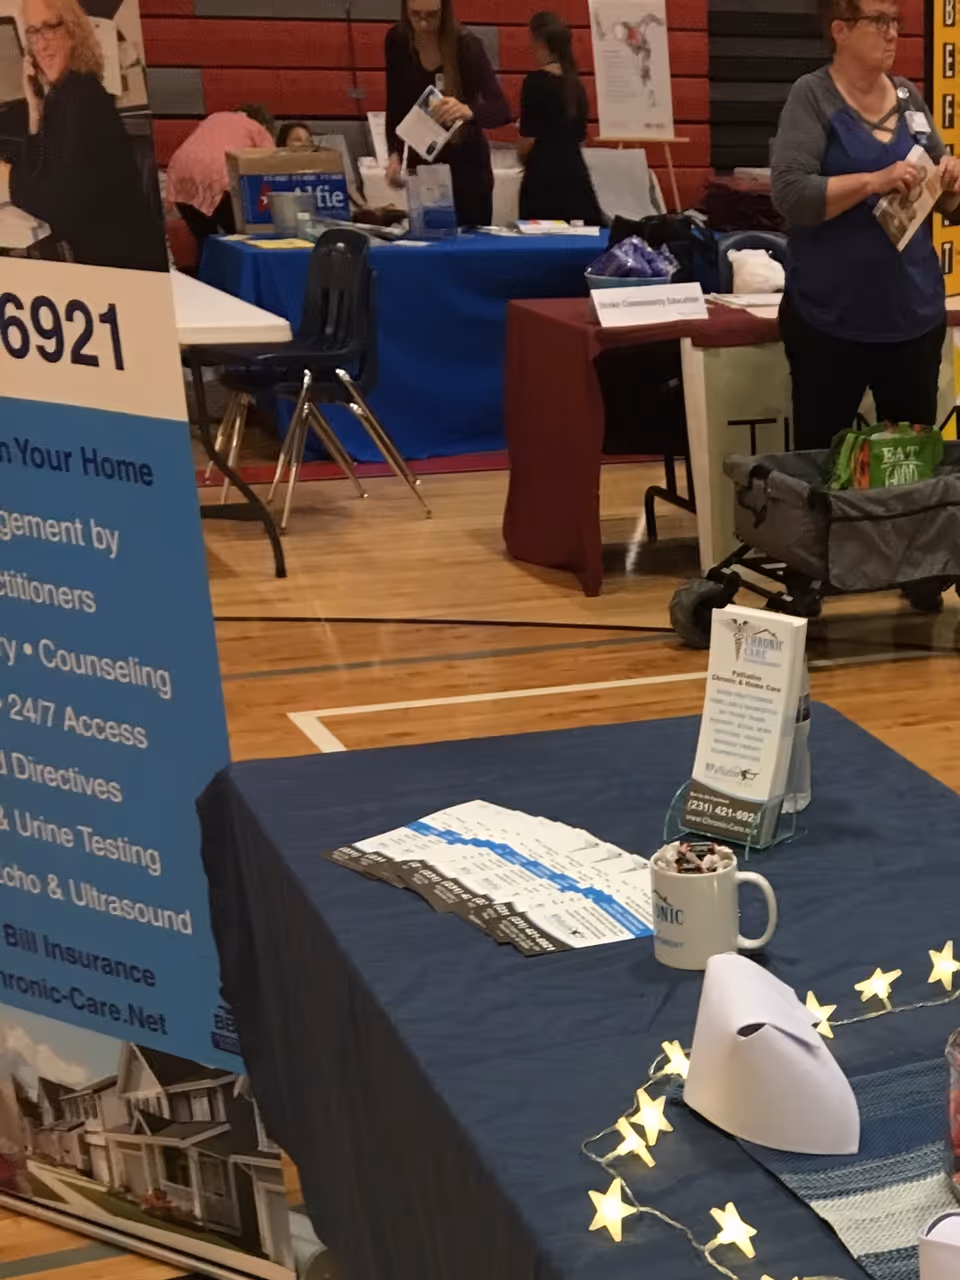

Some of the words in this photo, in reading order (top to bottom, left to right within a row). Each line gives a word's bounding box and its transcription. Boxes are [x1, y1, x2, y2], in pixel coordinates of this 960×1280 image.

[14, 437, 72, 473] Your
[80, 446, 154, 486] Home
[881, 445, 920, 463] EAT
[90, 518, 119, 559] by
[38, 639, 172, 699] Counseling
[8, 693, 55, 727] 24/7
[64, 706, 148, 749] Access
[11, 752, 122, 803] Directives
[687, 798, 713, 814] (231)
[14, 809, 74, 848] Urine
[76, 824, 162, 877] Testing
[47, 874, 64, 900] &
[68, 878, 193, 935] Ultrasound
[2, 923, 38, 954] Bill
[42, 934, 157, 987] Insurance
